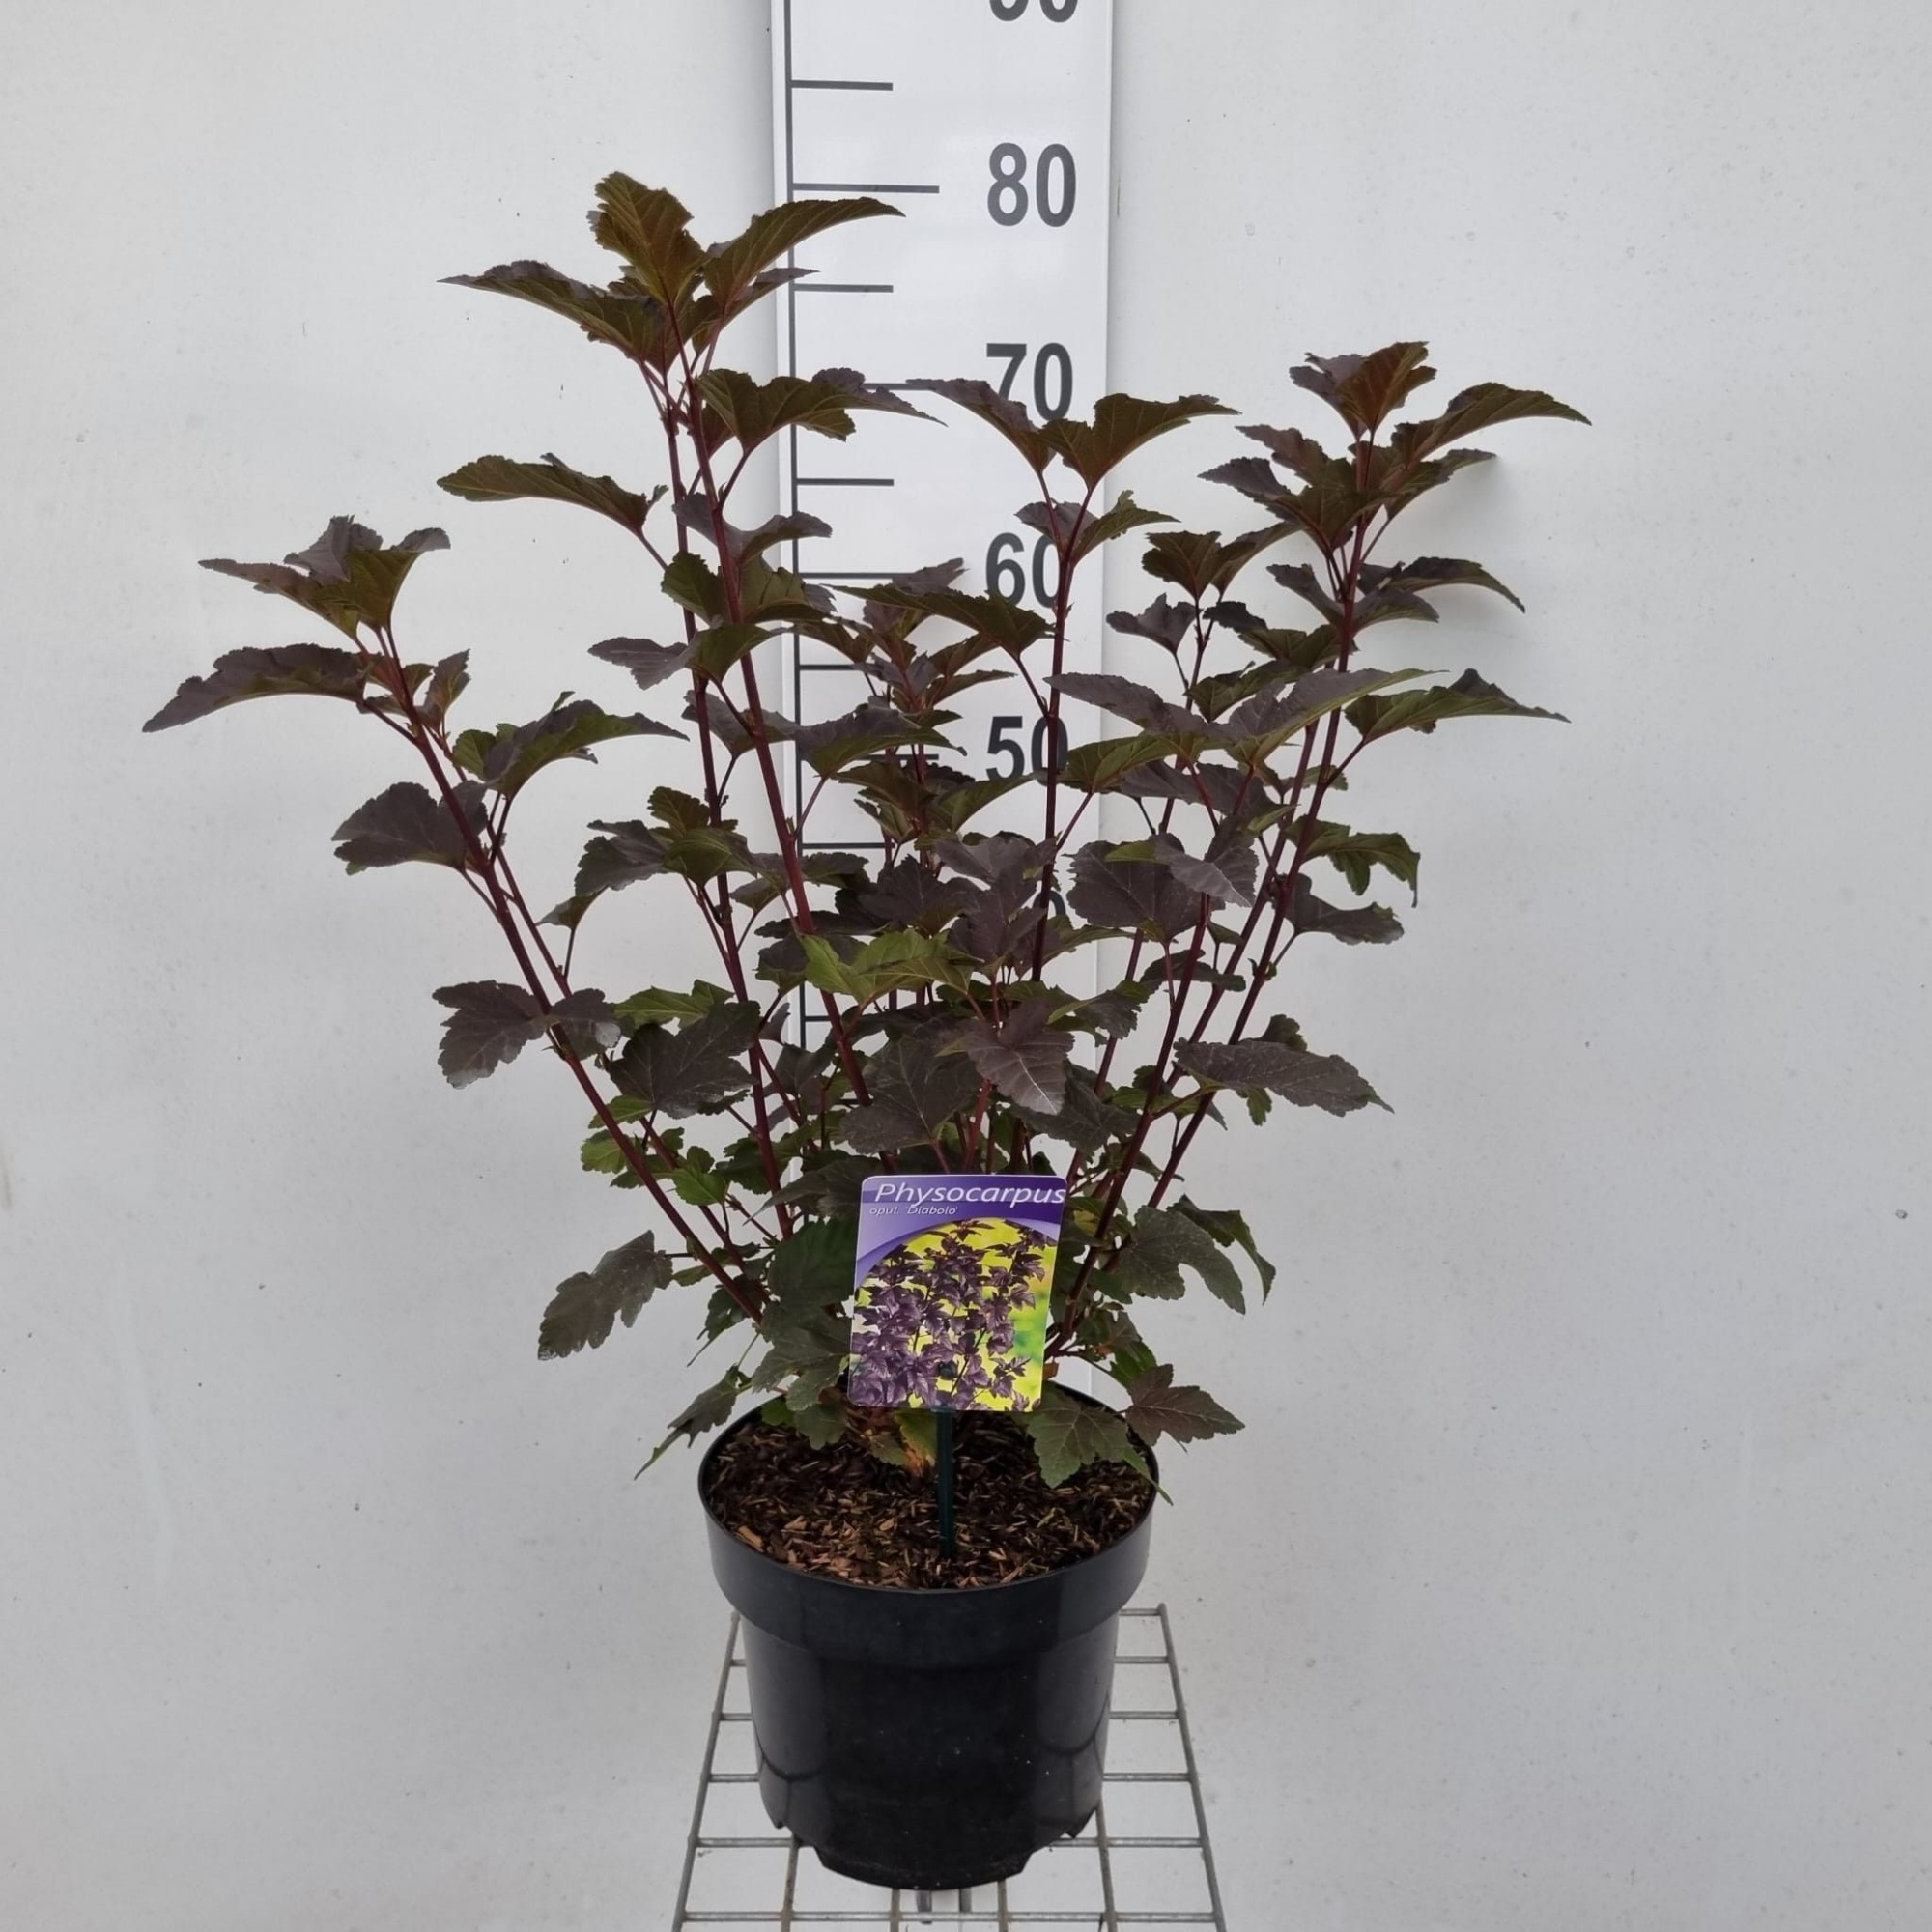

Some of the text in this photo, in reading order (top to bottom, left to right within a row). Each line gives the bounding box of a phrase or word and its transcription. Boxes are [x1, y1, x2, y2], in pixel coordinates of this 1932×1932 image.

[987, 142, 1076, 228] 80
[986, 342, 1073, 422] 70
[985, 715, 1069, 780] 50
[874, 1181, 1067, 1208] Physocarpus
